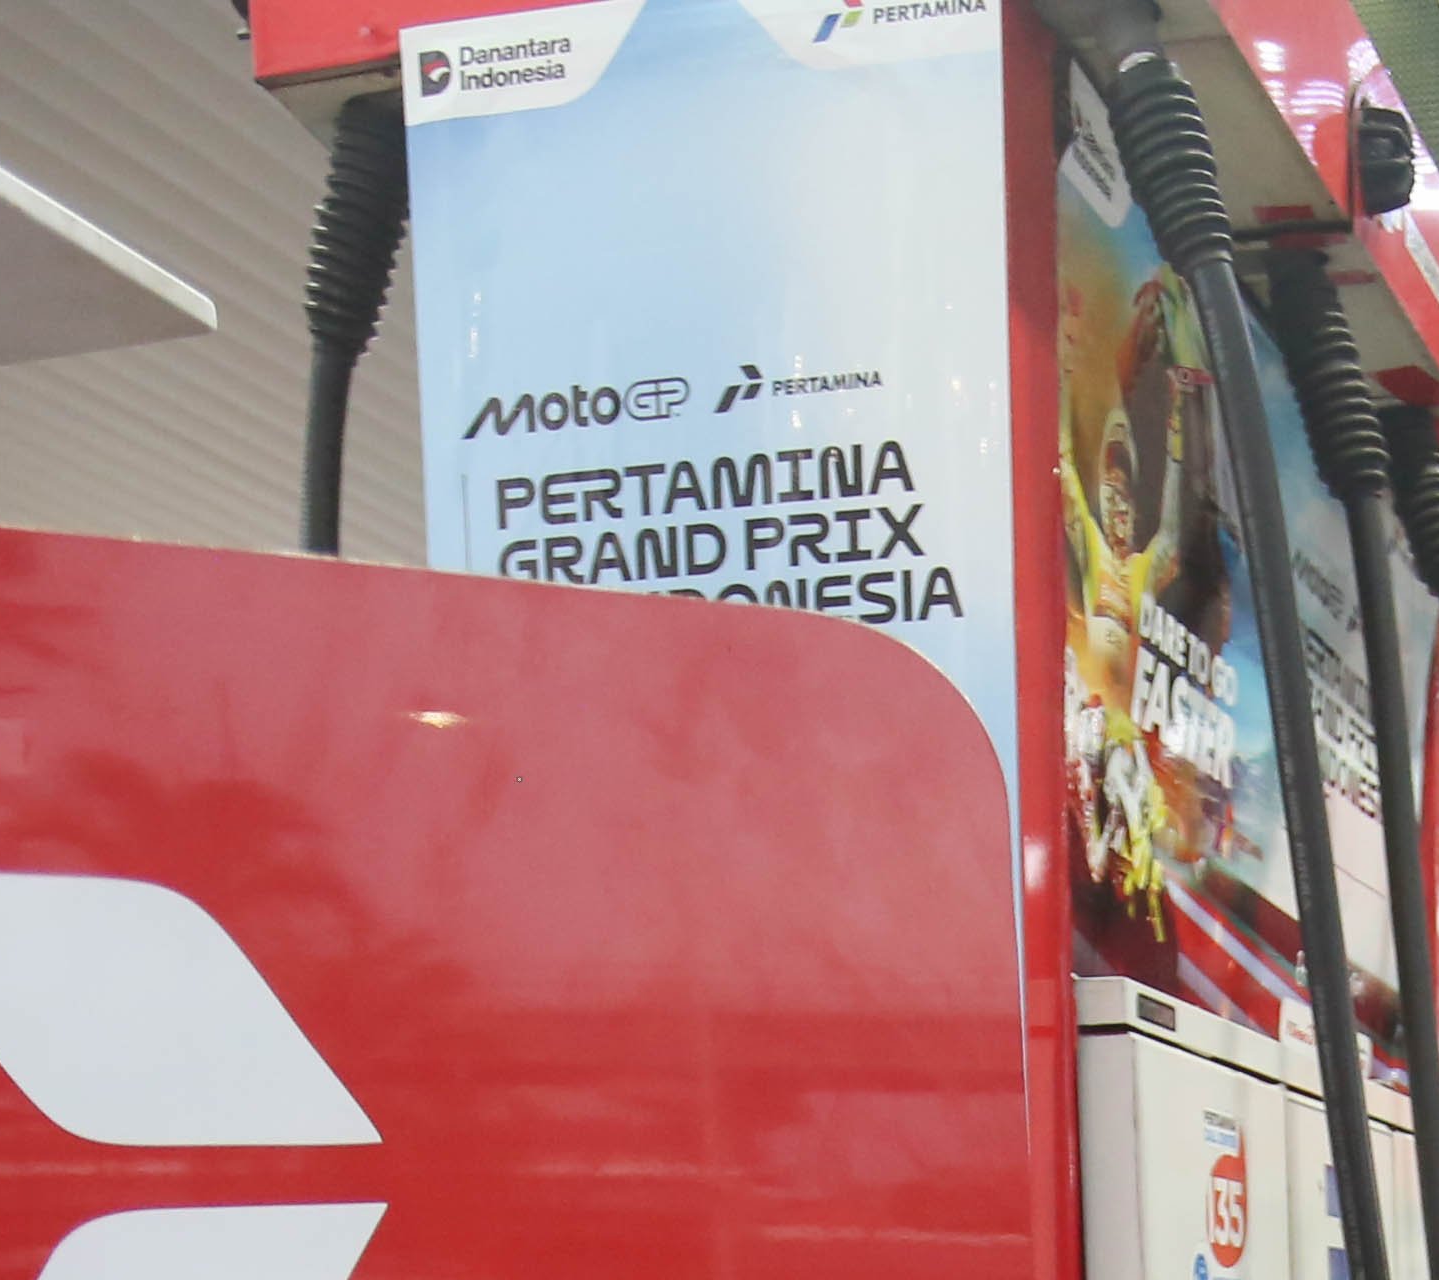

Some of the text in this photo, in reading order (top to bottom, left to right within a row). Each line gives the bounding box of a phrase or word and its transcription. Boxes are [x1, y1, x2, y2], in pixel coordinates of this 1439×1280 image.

[872, 0, 987, 25] PERTAMINA
[459, 37, 571, 67] Danantara
[460, 60, 566, 91] Indonesia
[771, 370, 883, 397] PERTAMINA
[496, 440, 915, 530] PERTAMINA
[499, 503, 925, 585] GRAND PRIX
[1131, 644, 1237, 790] FASTER
